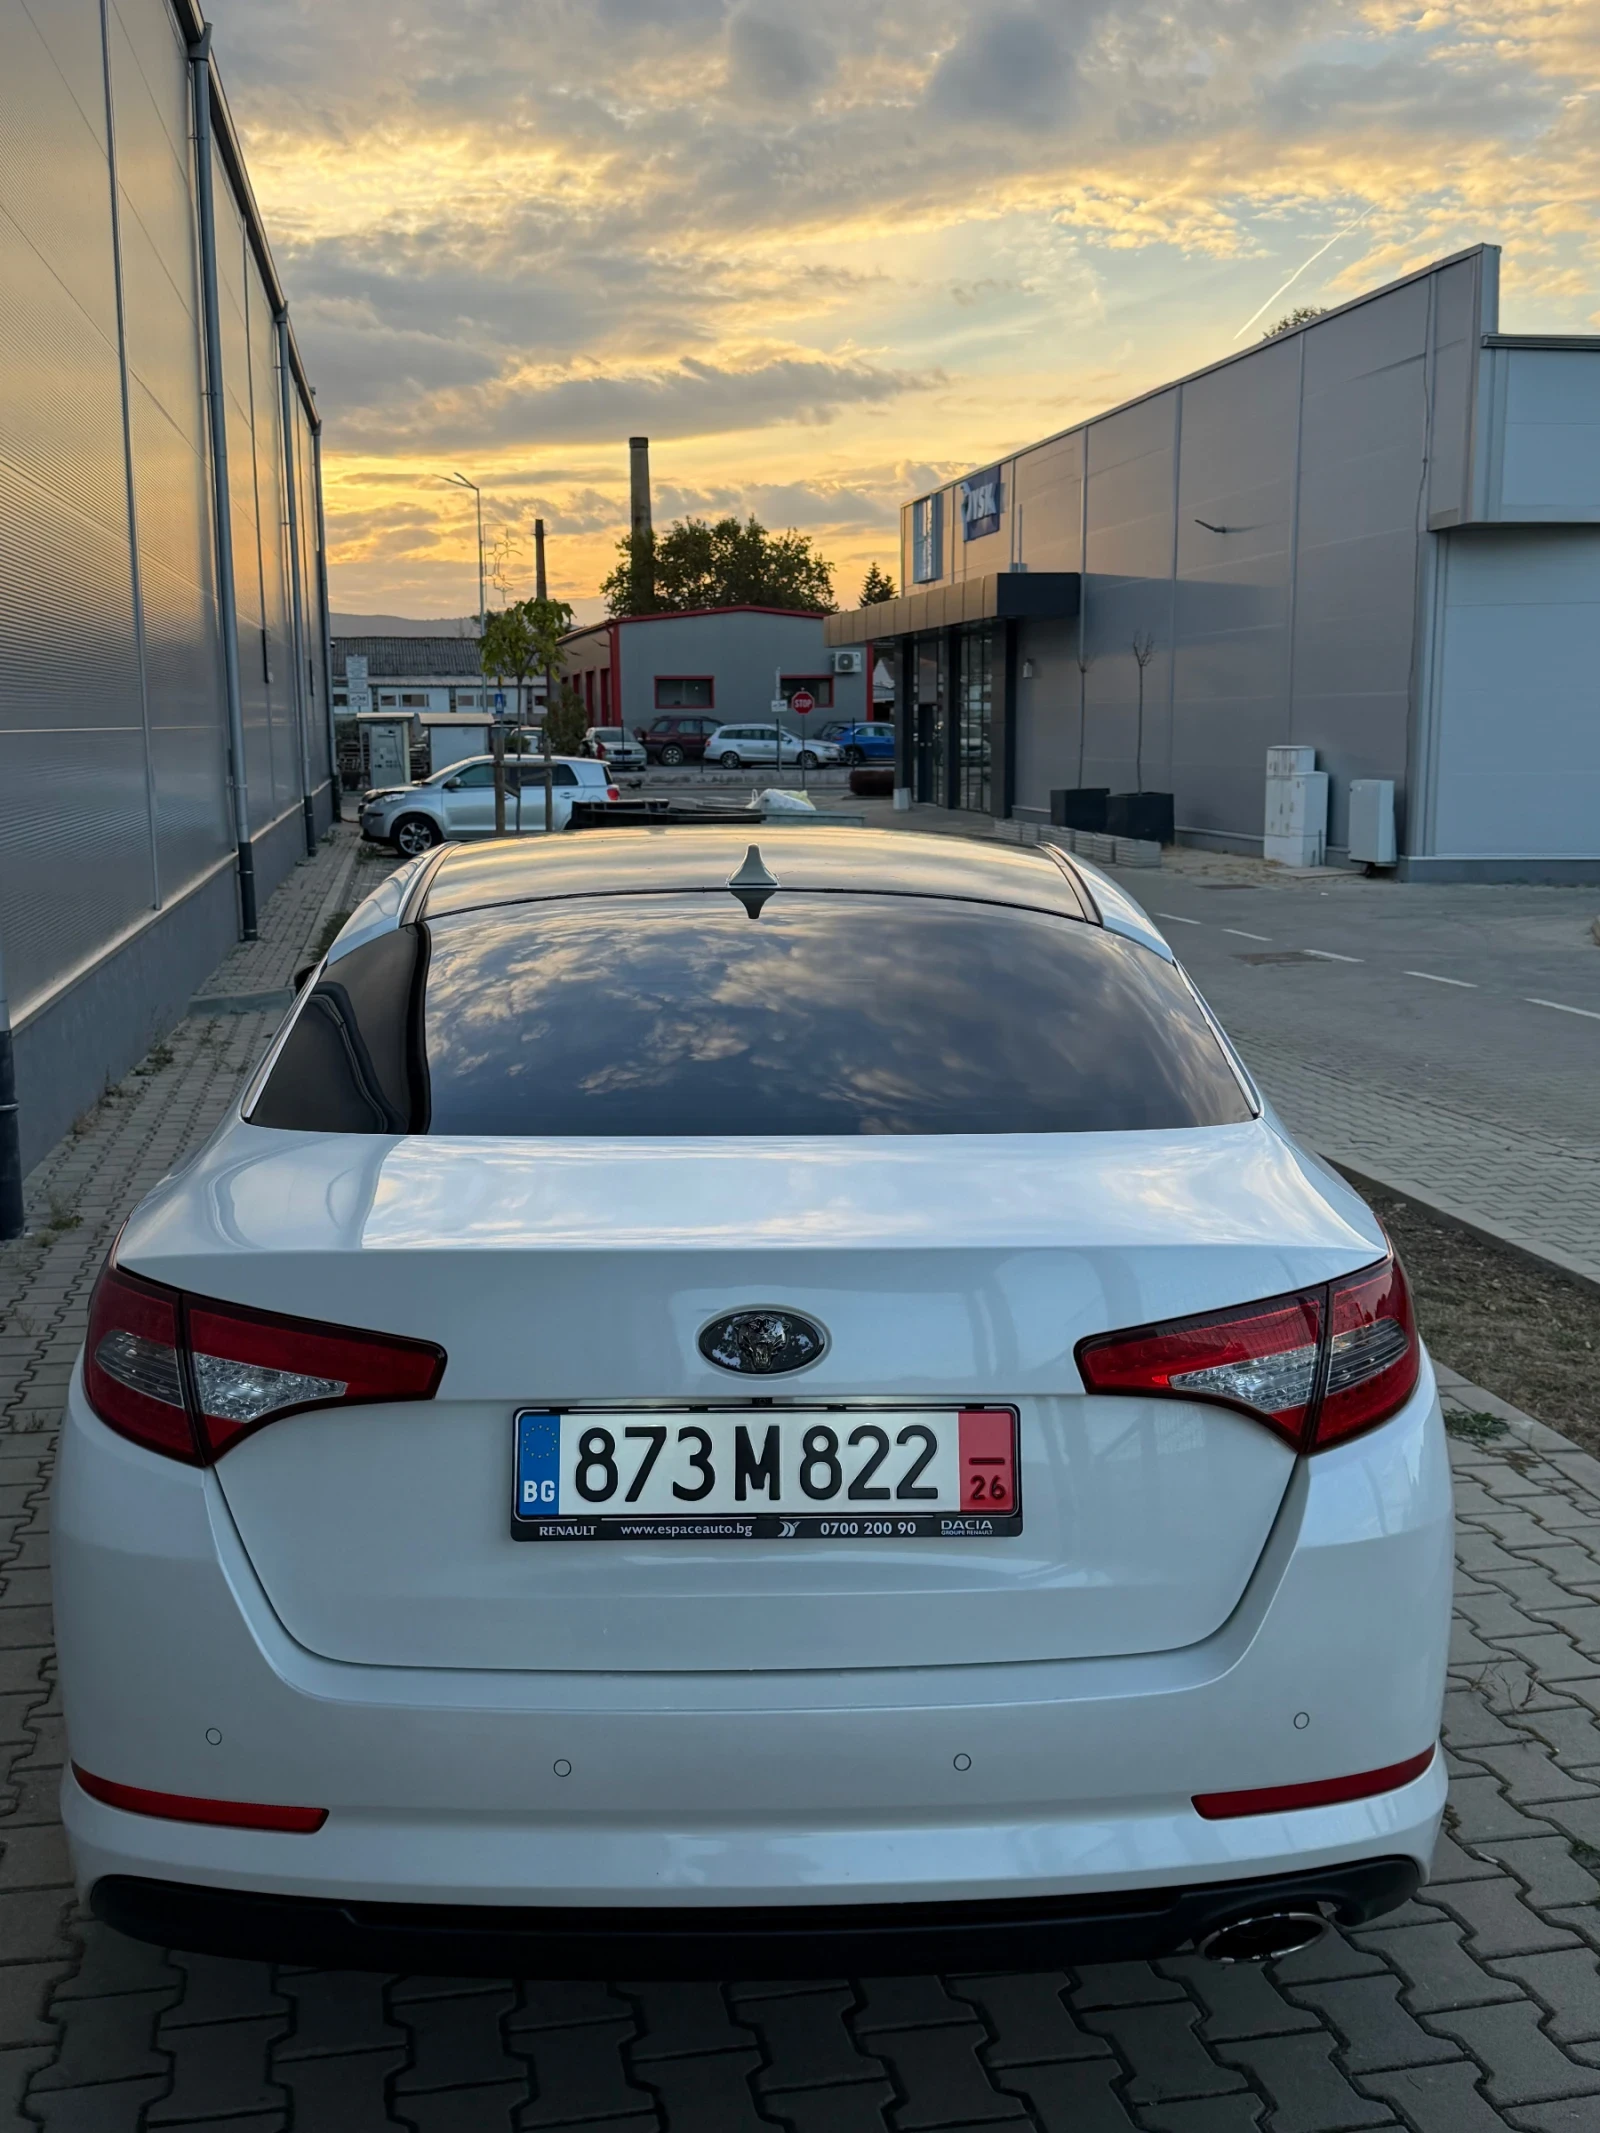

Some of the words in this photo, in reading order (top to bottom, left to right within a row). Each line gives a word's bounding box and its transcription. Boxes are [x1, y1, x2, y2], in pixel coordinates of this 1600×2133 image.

[966, 483, 997, 522] JYSK
[794, 699, 812, 708] STOP
[575, 1426, 715, 1502] 873
[735, 1425, 781, 1501] M
[799, 1424, 938, 1500] 822
[523, 1480, 555, 1502] BG
[970, 1475, 1006, 1500] 26
[539, 1525, 597, 1536] RENAULT
[620, 1522, 753, 1537] www.espaceauto.bg
[820, 1522, 858, 1535] 0700
[863, 1522, 892, 1535] 200
[897, 1522, 916, 1535] 90
[941, 1520, 993, 1530] DACIA
